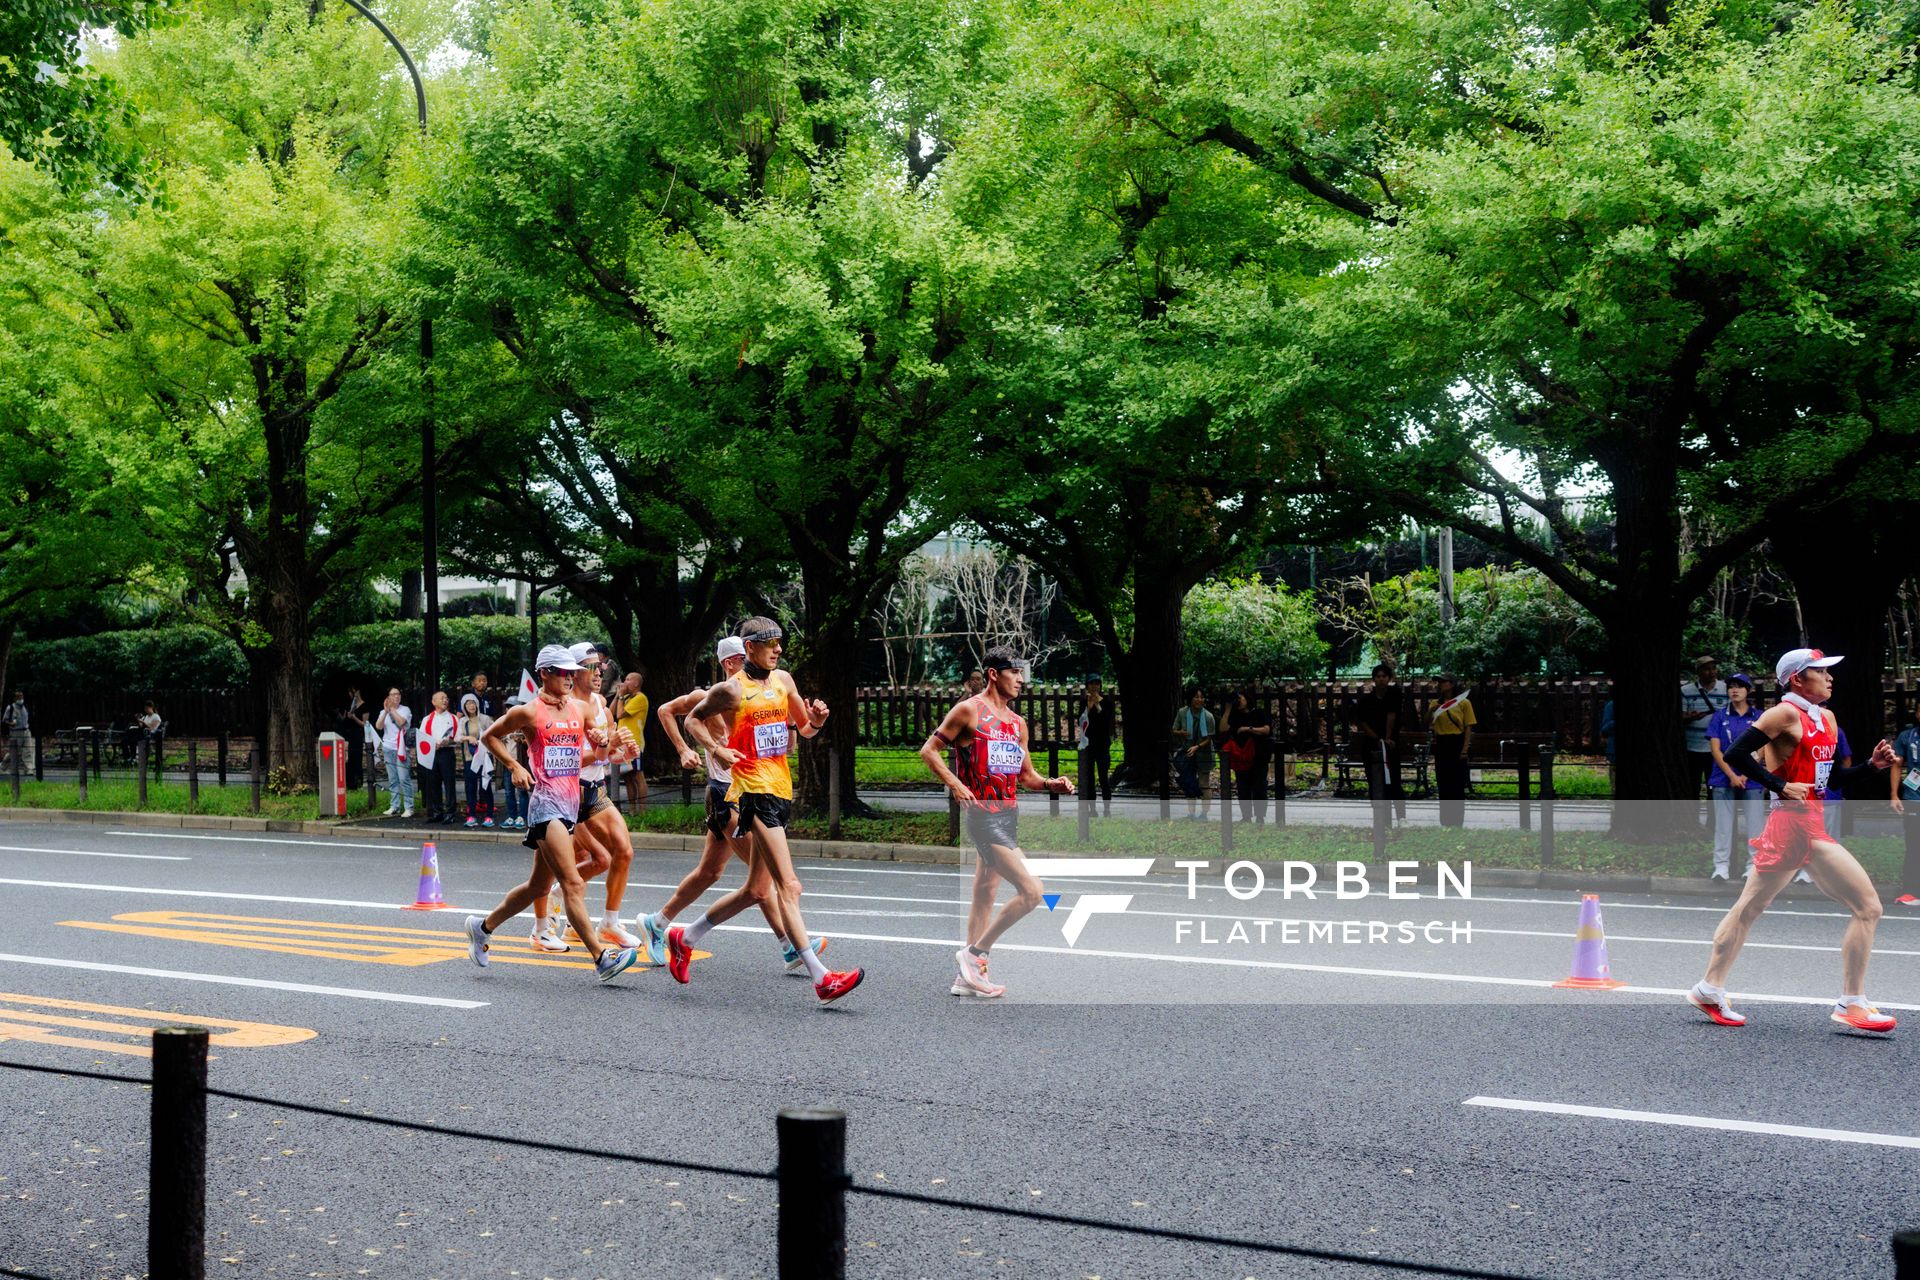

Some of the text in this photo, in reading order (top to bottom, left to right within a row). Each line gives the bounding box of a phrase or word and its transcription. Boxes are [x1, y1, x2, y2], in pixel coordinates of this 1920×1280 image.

[752, 708, 785, 720] GERMANY
[769, 722, 788, 735] TDK
[548, 733, 579, 744] JAPAN
[557, 747, 580, 756] TDK
[1000, 742, 1022, 753] TDK
[546, 758, 574, 768] MARUO
[990, 754, 1022, 765] SALAZAR
